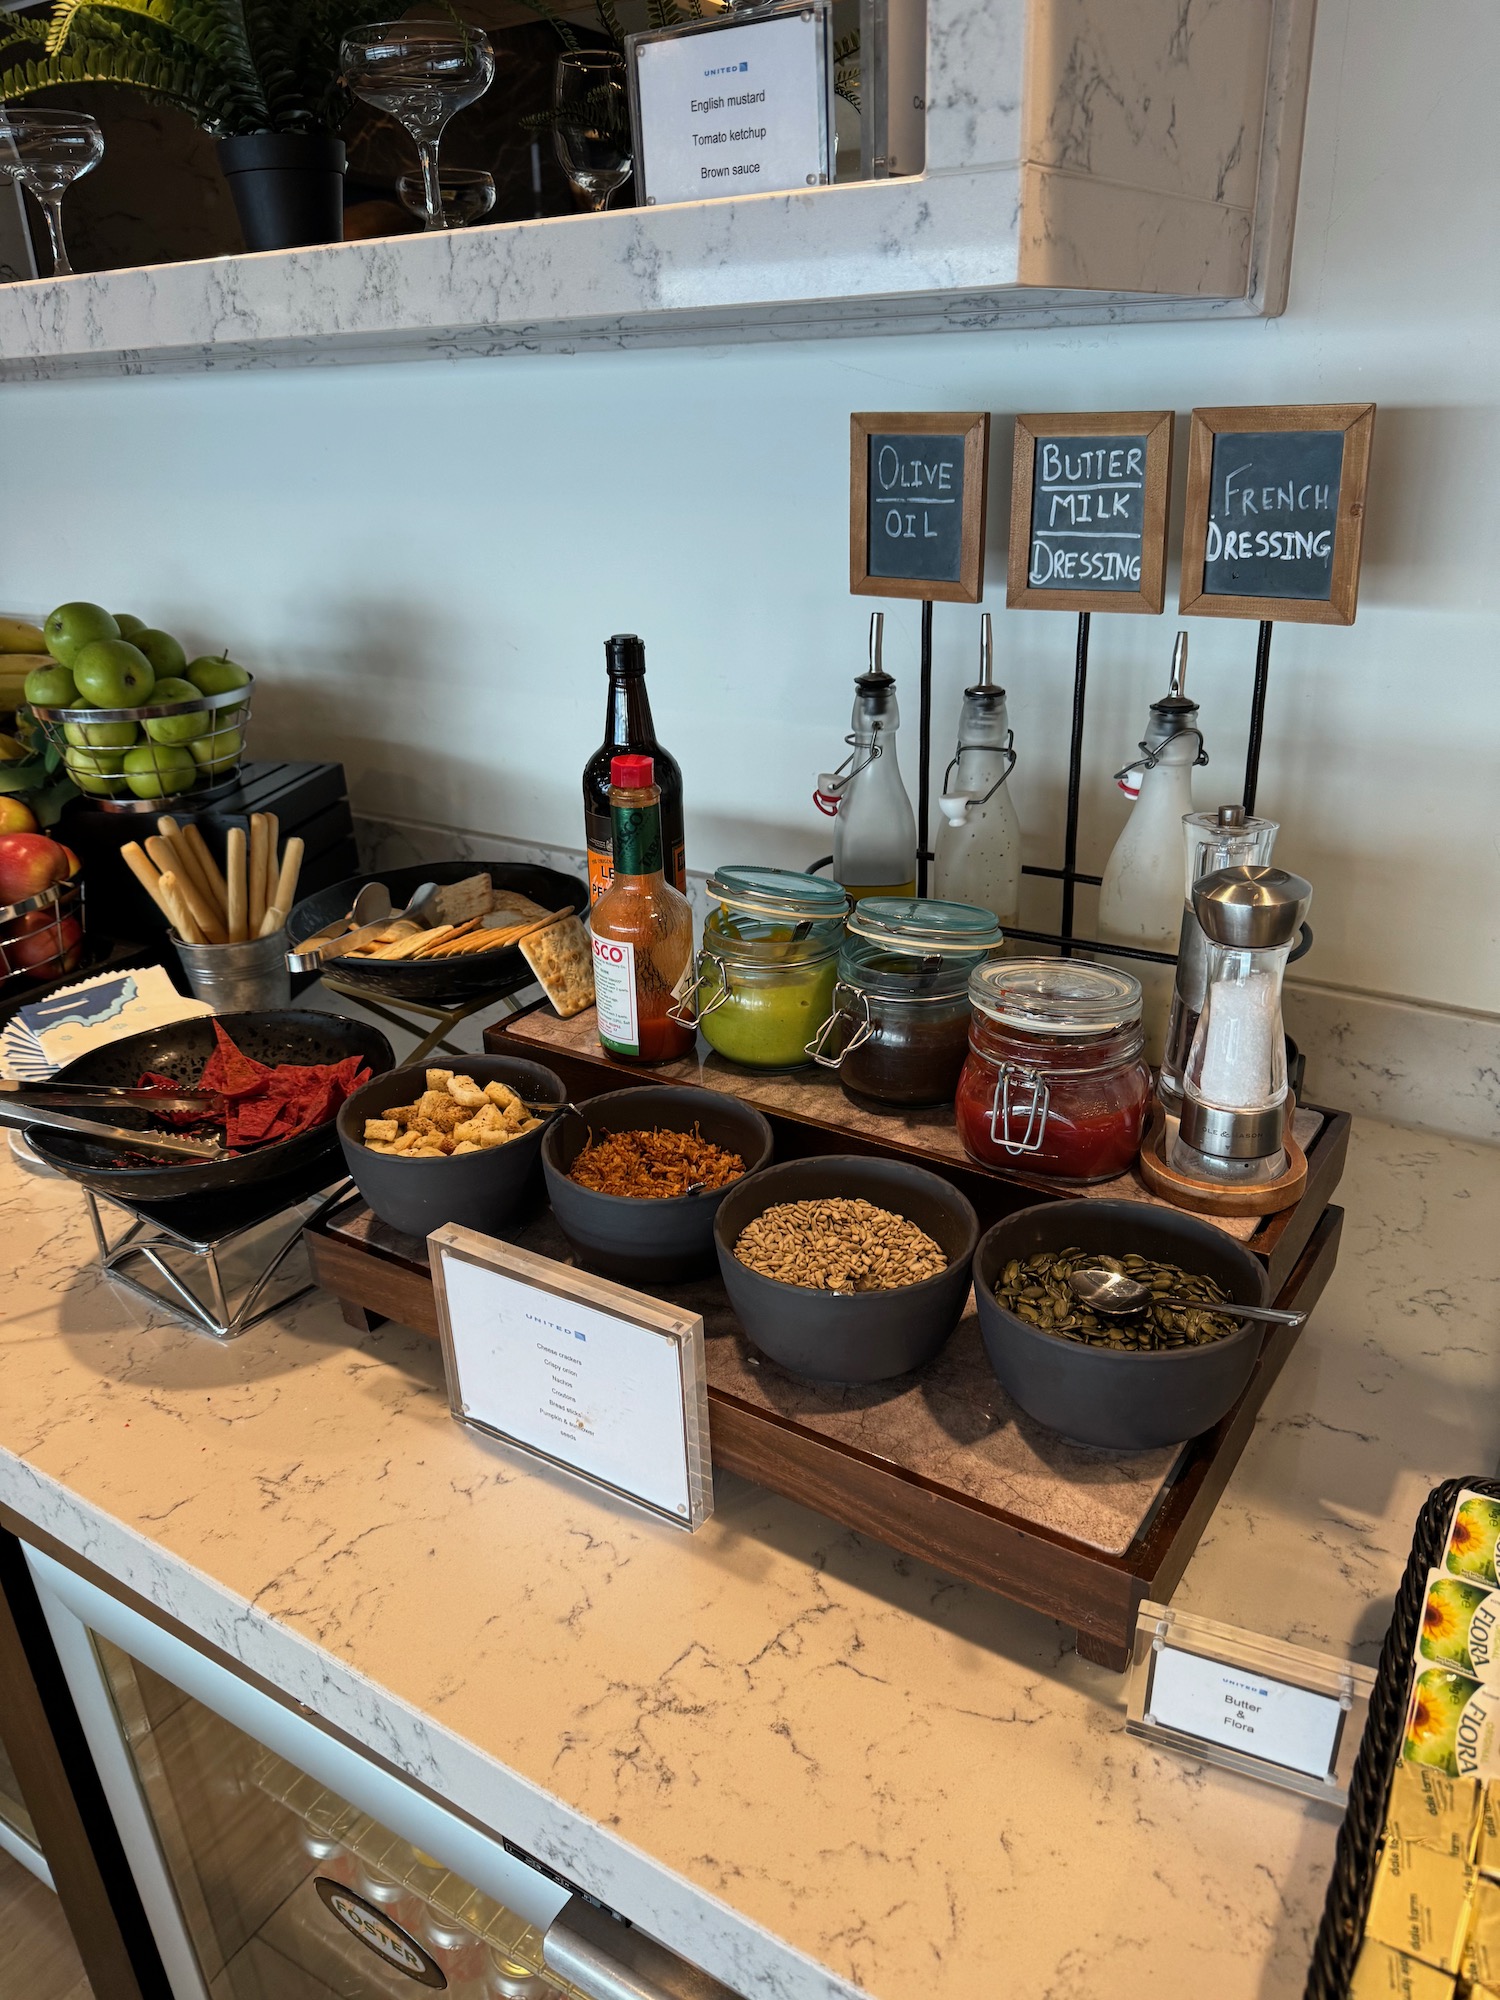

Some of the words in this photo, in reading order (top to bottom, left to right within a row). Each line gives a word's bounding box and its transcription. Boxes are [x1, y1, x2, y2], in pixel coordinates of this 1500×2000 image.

[704, 65, 738, 77] UNITED
[691, 97, 724, 113] English
[727, 90, 765, 107] mustard
[692, 131, 727, 147] Tomato
[729, 126, 767, 142] ketchup
[700, 165, 730, 179] Brown
[732, 162, 760, 174] sauce
[878, 444, 953, 491] OLIVE
[1042, 443, 1144, 483] BUTTER
[1224, 462, 1330, 517] FRENCH
[1048, 492, 1130, 527] MILK
[885, 507, 938, 539] OIL
[1205, 520, 1332, 562] DRESSING
[1029, 538, 1141, 585] DRESSING
[592, 940, 623, 963] SCO
[525, 1313, 572, 1334] UNITED
[536, 1342, 558, 1356] Cheese
[558, 1352, 582, 1366] crackers
[543, 1358, 561, 1371] Crispy
[562, 1367, 578, 1378] onion
[551, 1375, 573, 1388] Nachos
[551, 1387, 576, 1403] Croutons
[539, 1407, 563, 1423] Pumpkin
[549, 1399, 565, 1411] Bread
[566, 1407, 582, 1418] sticks
[560, 1430, 577, 1441] seeds
[1469, 1606, 1496, 1667] FLORA
[1222, 1678, 1258, 1692] UNITED
[1224, 1694, 1262, 1714] Butter
[1236, 1709, 1245, 1719] &
[1223, 1716, 1255, 1734] Flora
[1456, 1701, 1487, 1774] FLORA
[334, 1899, 421, 1969] FOSTER
